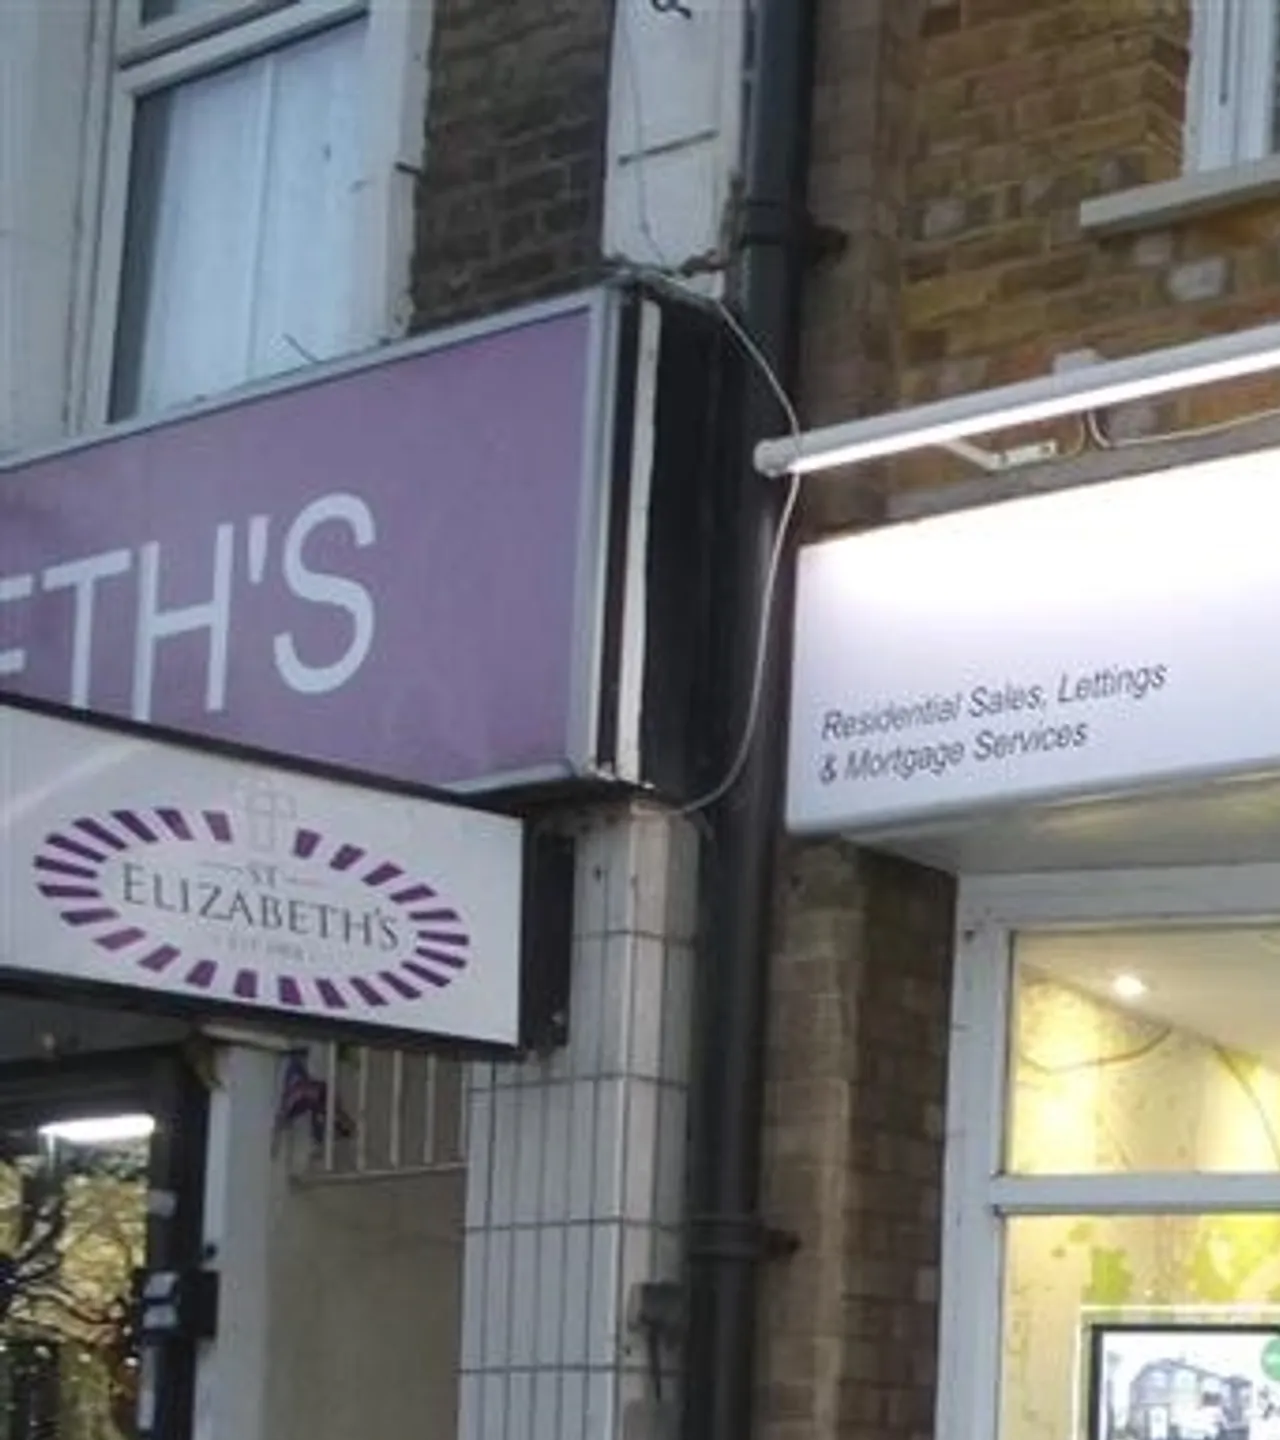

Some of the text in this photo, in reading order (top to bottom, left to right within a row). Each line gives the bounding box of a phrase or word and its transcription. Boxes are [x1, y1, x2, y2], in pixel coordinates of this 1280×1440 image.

[821, 663, 1168, 741] Residential Sales, Lettings
[818, 720, 1089, 785] & Mortgage Services
[122, 862, 400, 952] ELIZABETH'S
